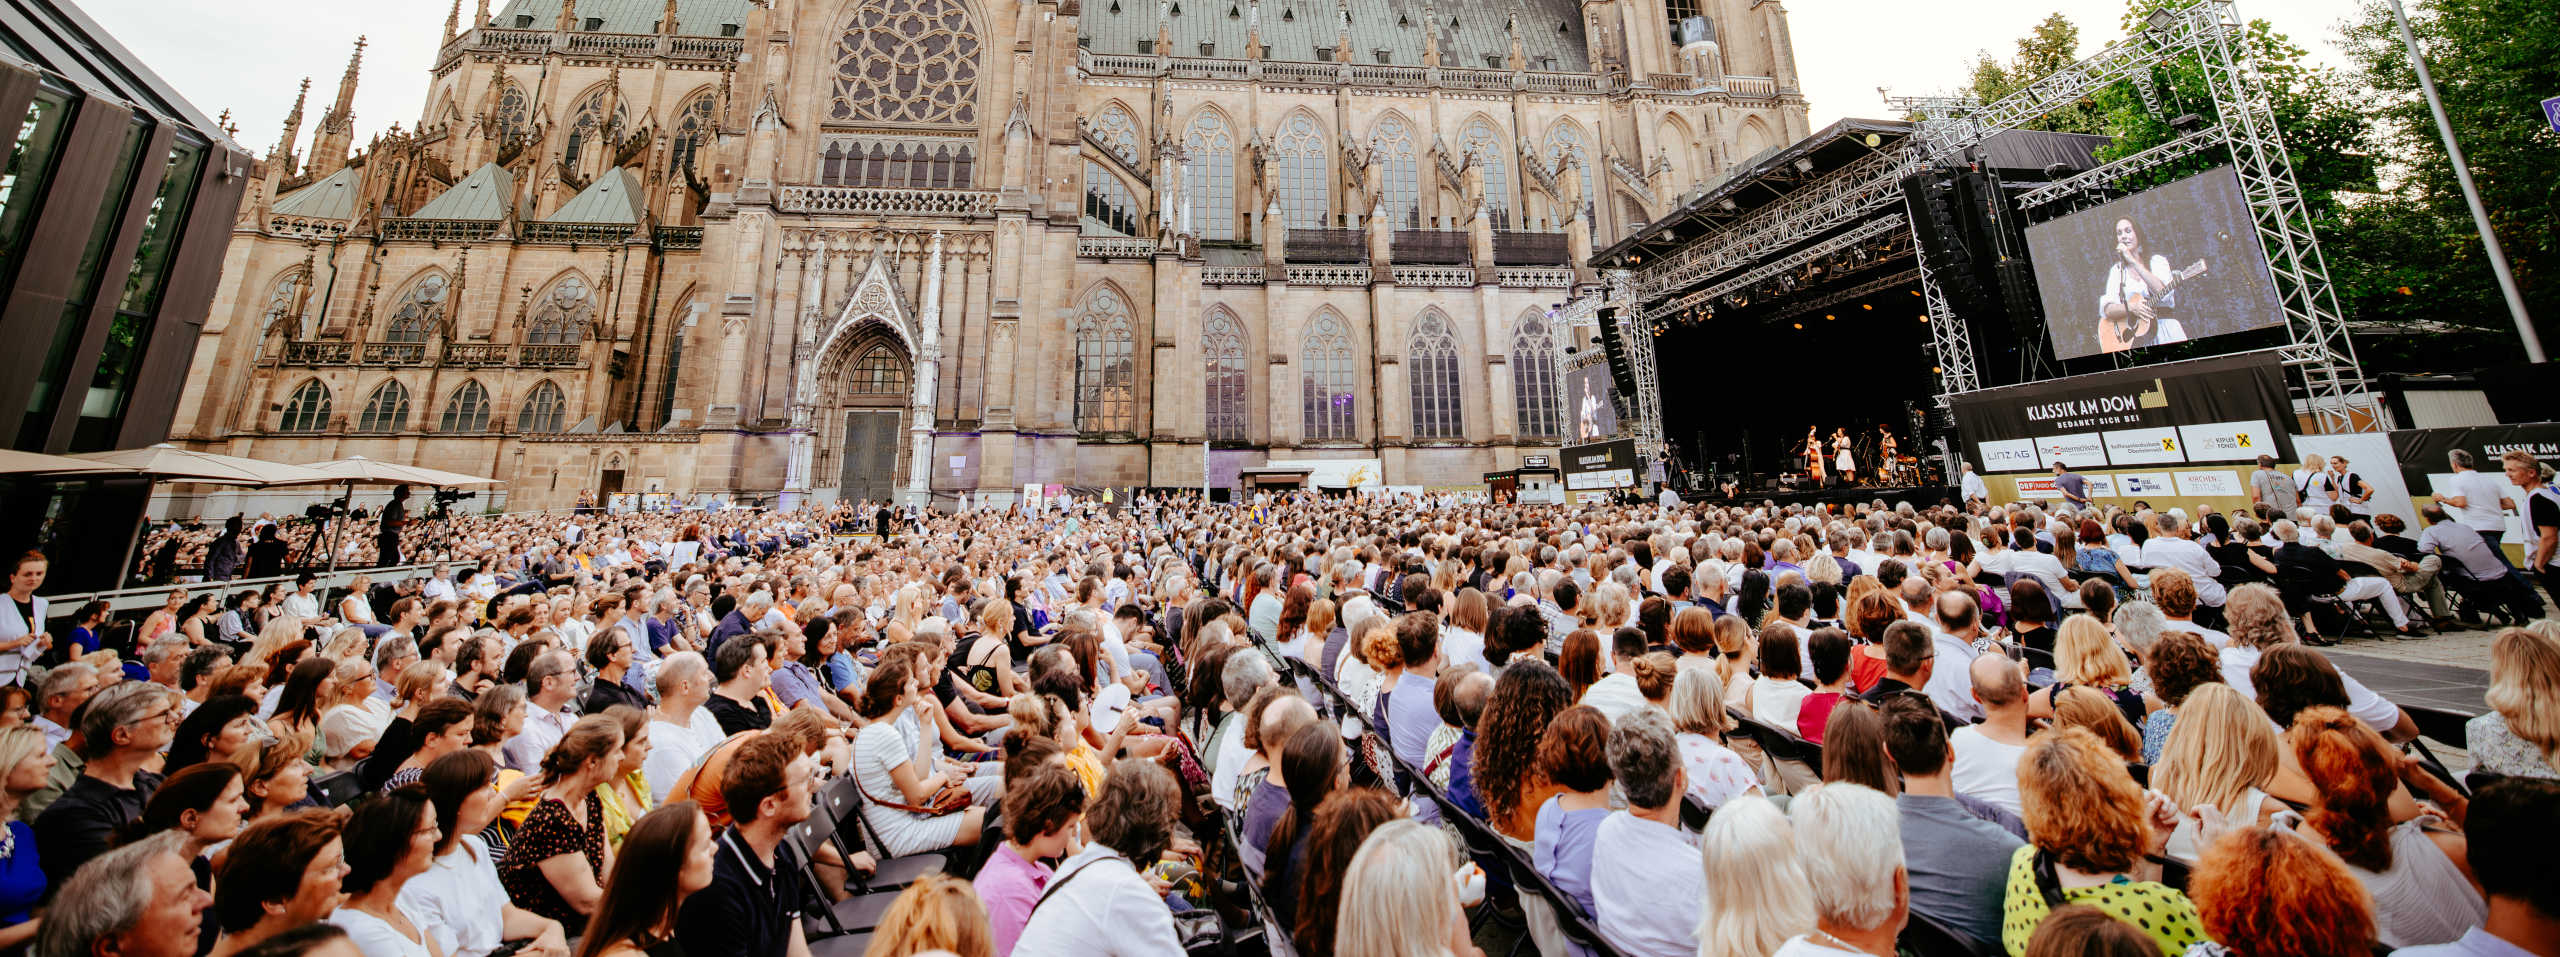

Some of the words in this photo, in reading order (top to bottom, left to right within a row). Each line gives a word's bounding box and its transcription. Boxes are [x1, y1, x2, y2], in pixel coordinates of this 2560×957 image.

[2027, 402, 2078, 421] KLASSIK
[2080, 399, 2099, 415] AM
[2100, 394, 2137, 412] DOM
[2057, 419, 2096, 429] BEDANKT
[2099, 417, 2121, 425] SICH
[2014, 450, 2030, 458] AG
[2539, 443, 2559, 454] AM
